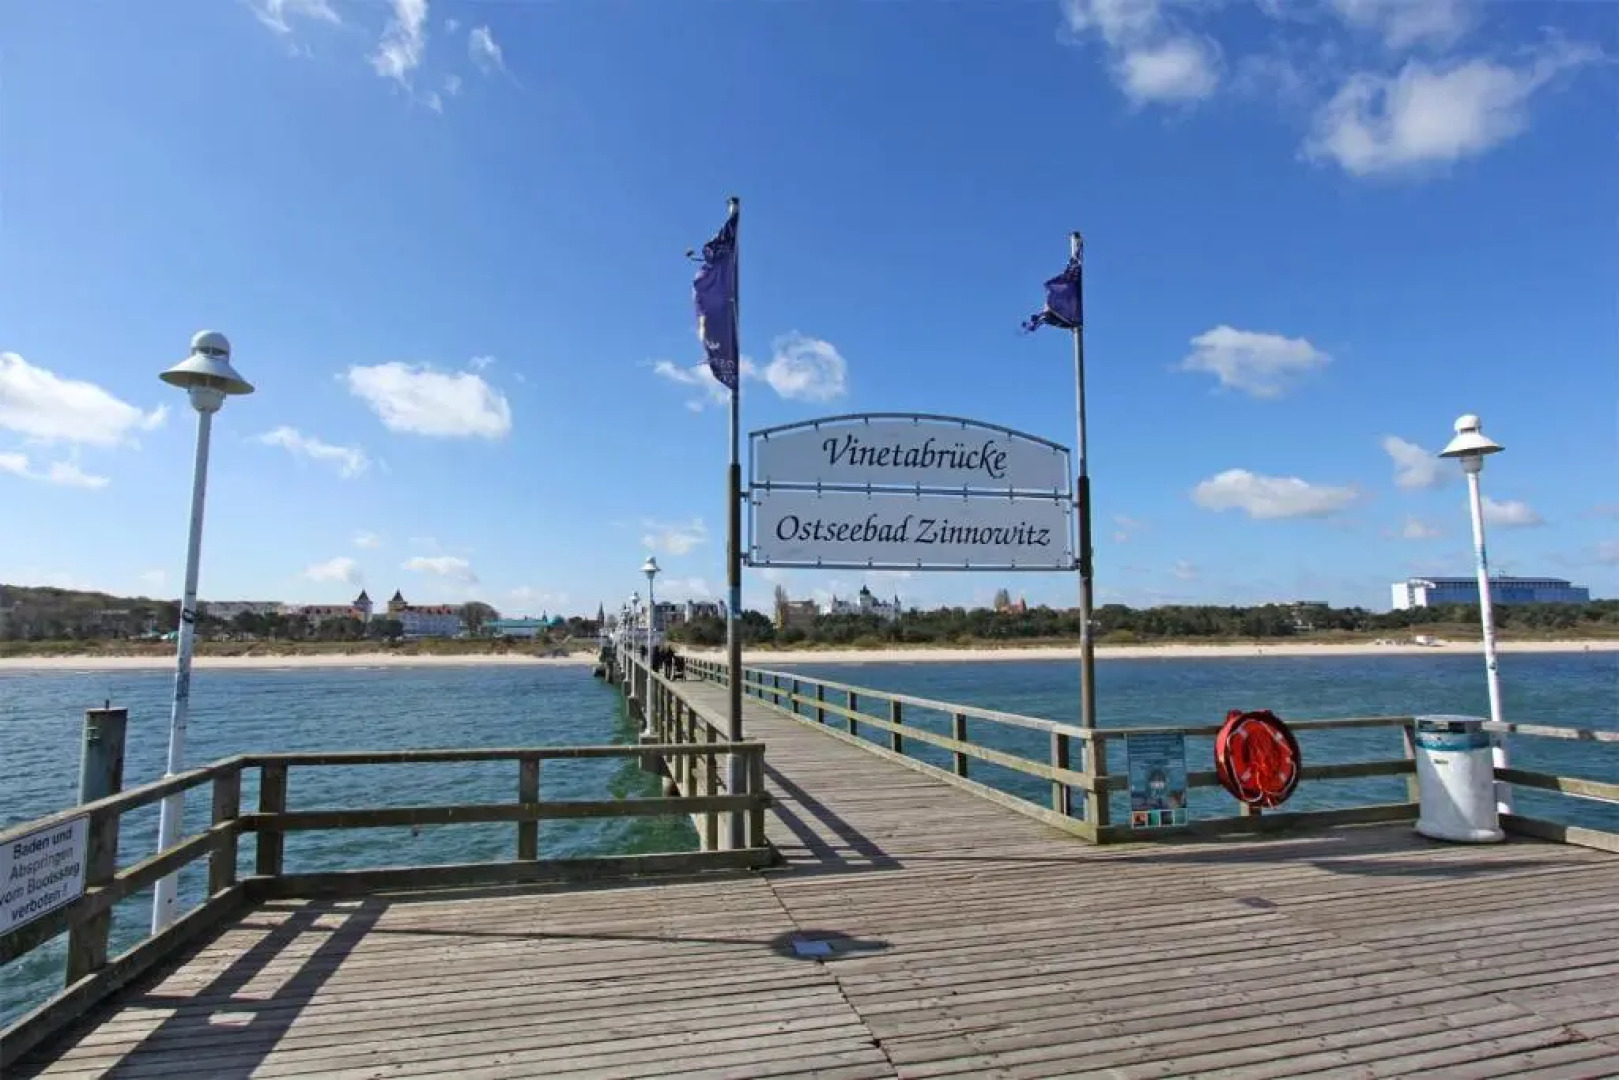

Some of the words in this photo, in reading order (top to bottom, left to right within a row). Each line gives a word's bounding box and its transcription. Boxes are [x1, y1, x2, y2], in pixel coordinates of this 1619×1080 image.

[822, 434, 1008, 479] Vinetabrücke
[776, 514, 914, 545] Ostseebad
[915, 518, 1051, 547] Zinnowitz
[13, 837, 50, 860] Baden
[53, 826, 73, 846] und
[10, 847, 74, 881] Abspringen
